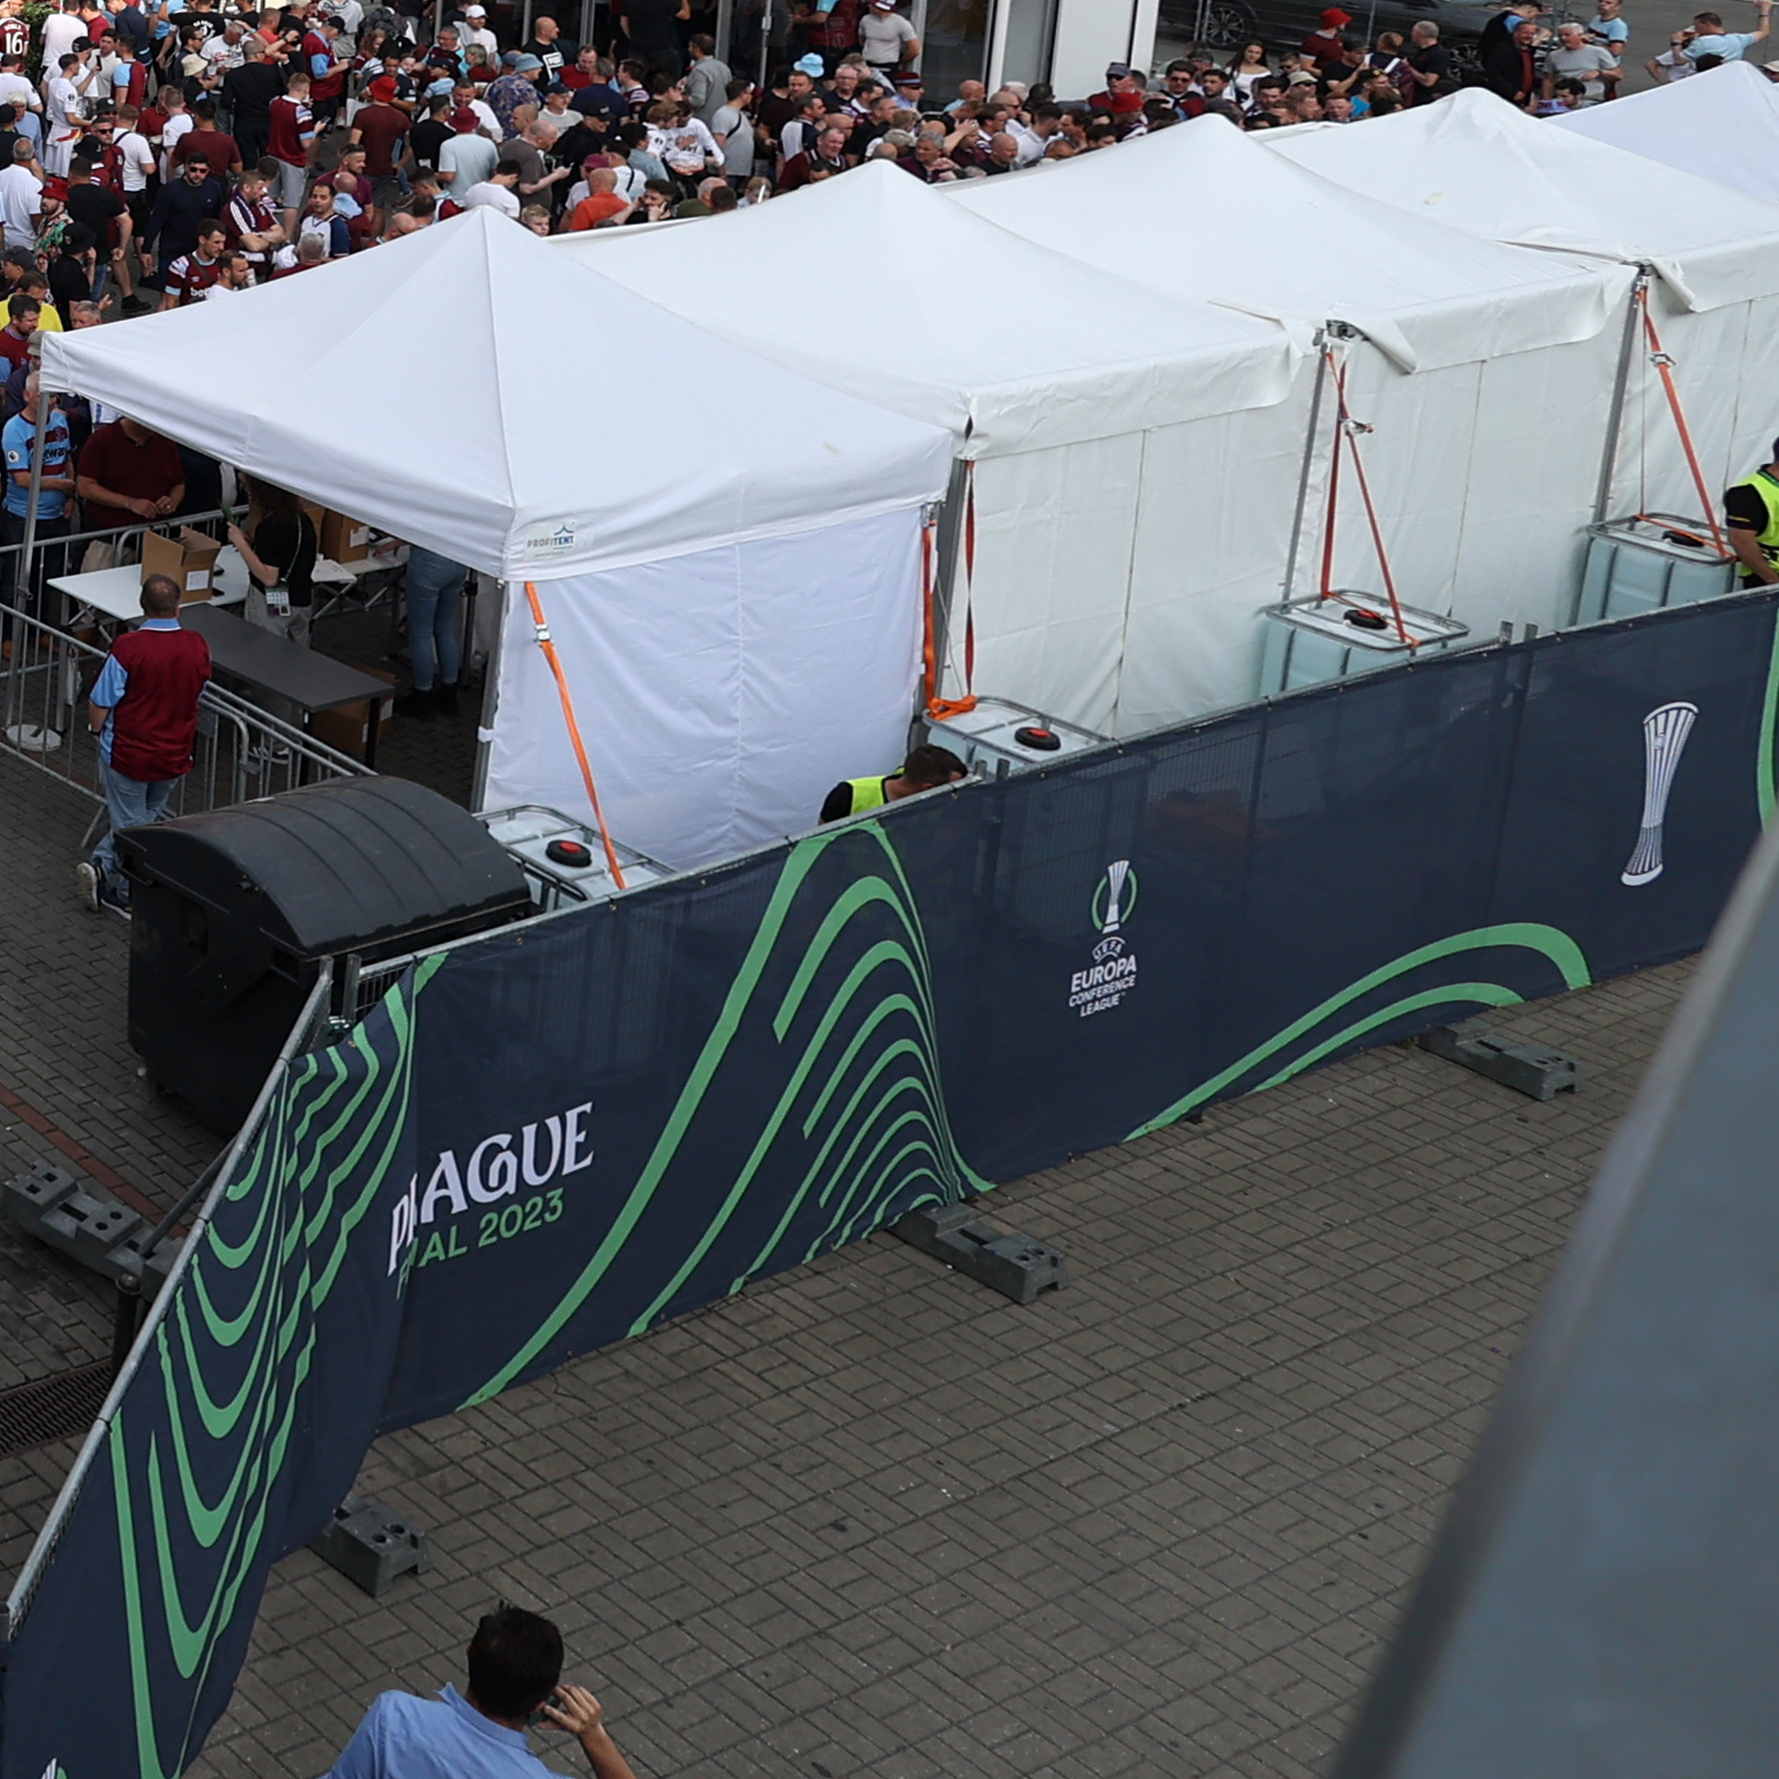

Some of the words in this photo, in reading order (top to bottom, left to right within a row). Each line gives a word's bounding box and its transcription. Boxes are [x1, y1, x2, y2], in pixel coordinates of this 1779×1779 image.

[5, 31, 23, 52] 16
[1093, 940, 1123, 960] UEFA
[1068, 974, 1137, 1008] CONFERENCE
[1070, 954, 1137, 994] EUROPA
[478, 1187, 565, 1249] 2023
